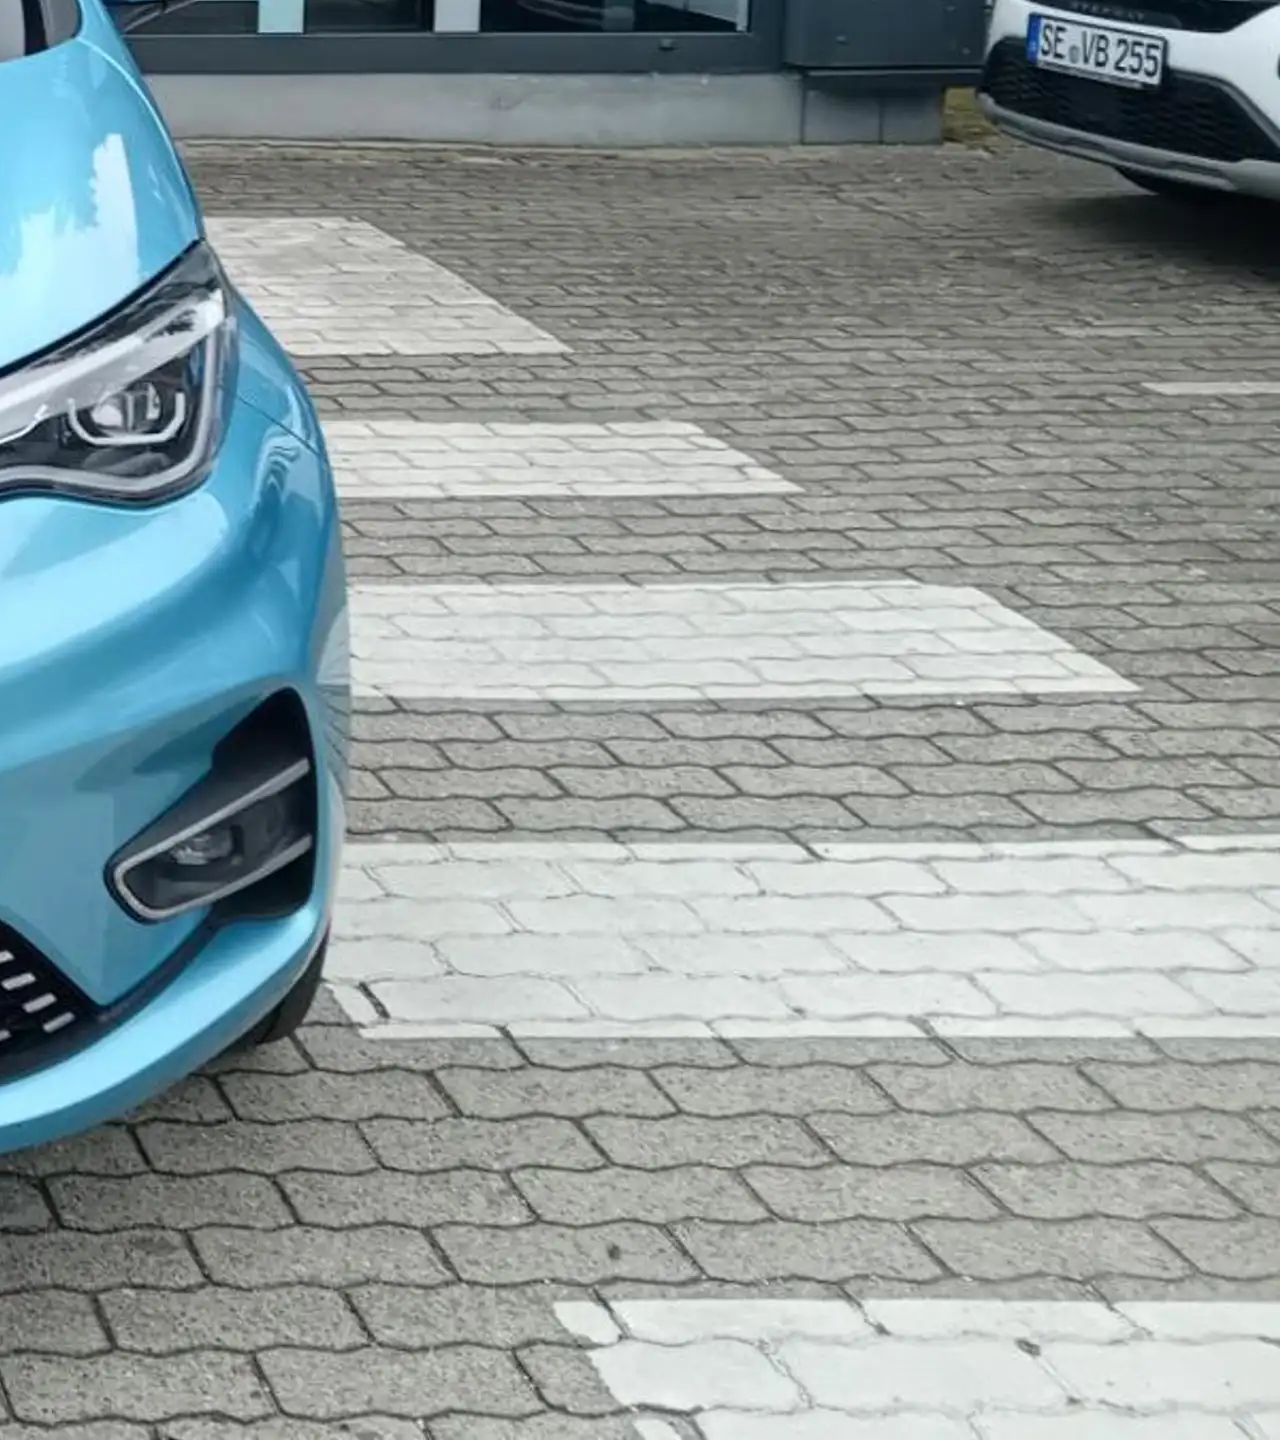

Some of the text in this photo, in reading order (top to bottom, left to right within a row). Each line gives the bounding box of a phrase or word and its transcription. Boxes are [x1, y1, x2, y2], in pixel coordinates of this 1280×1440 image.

[1040, 23, 1161, 78] SE VB 255
